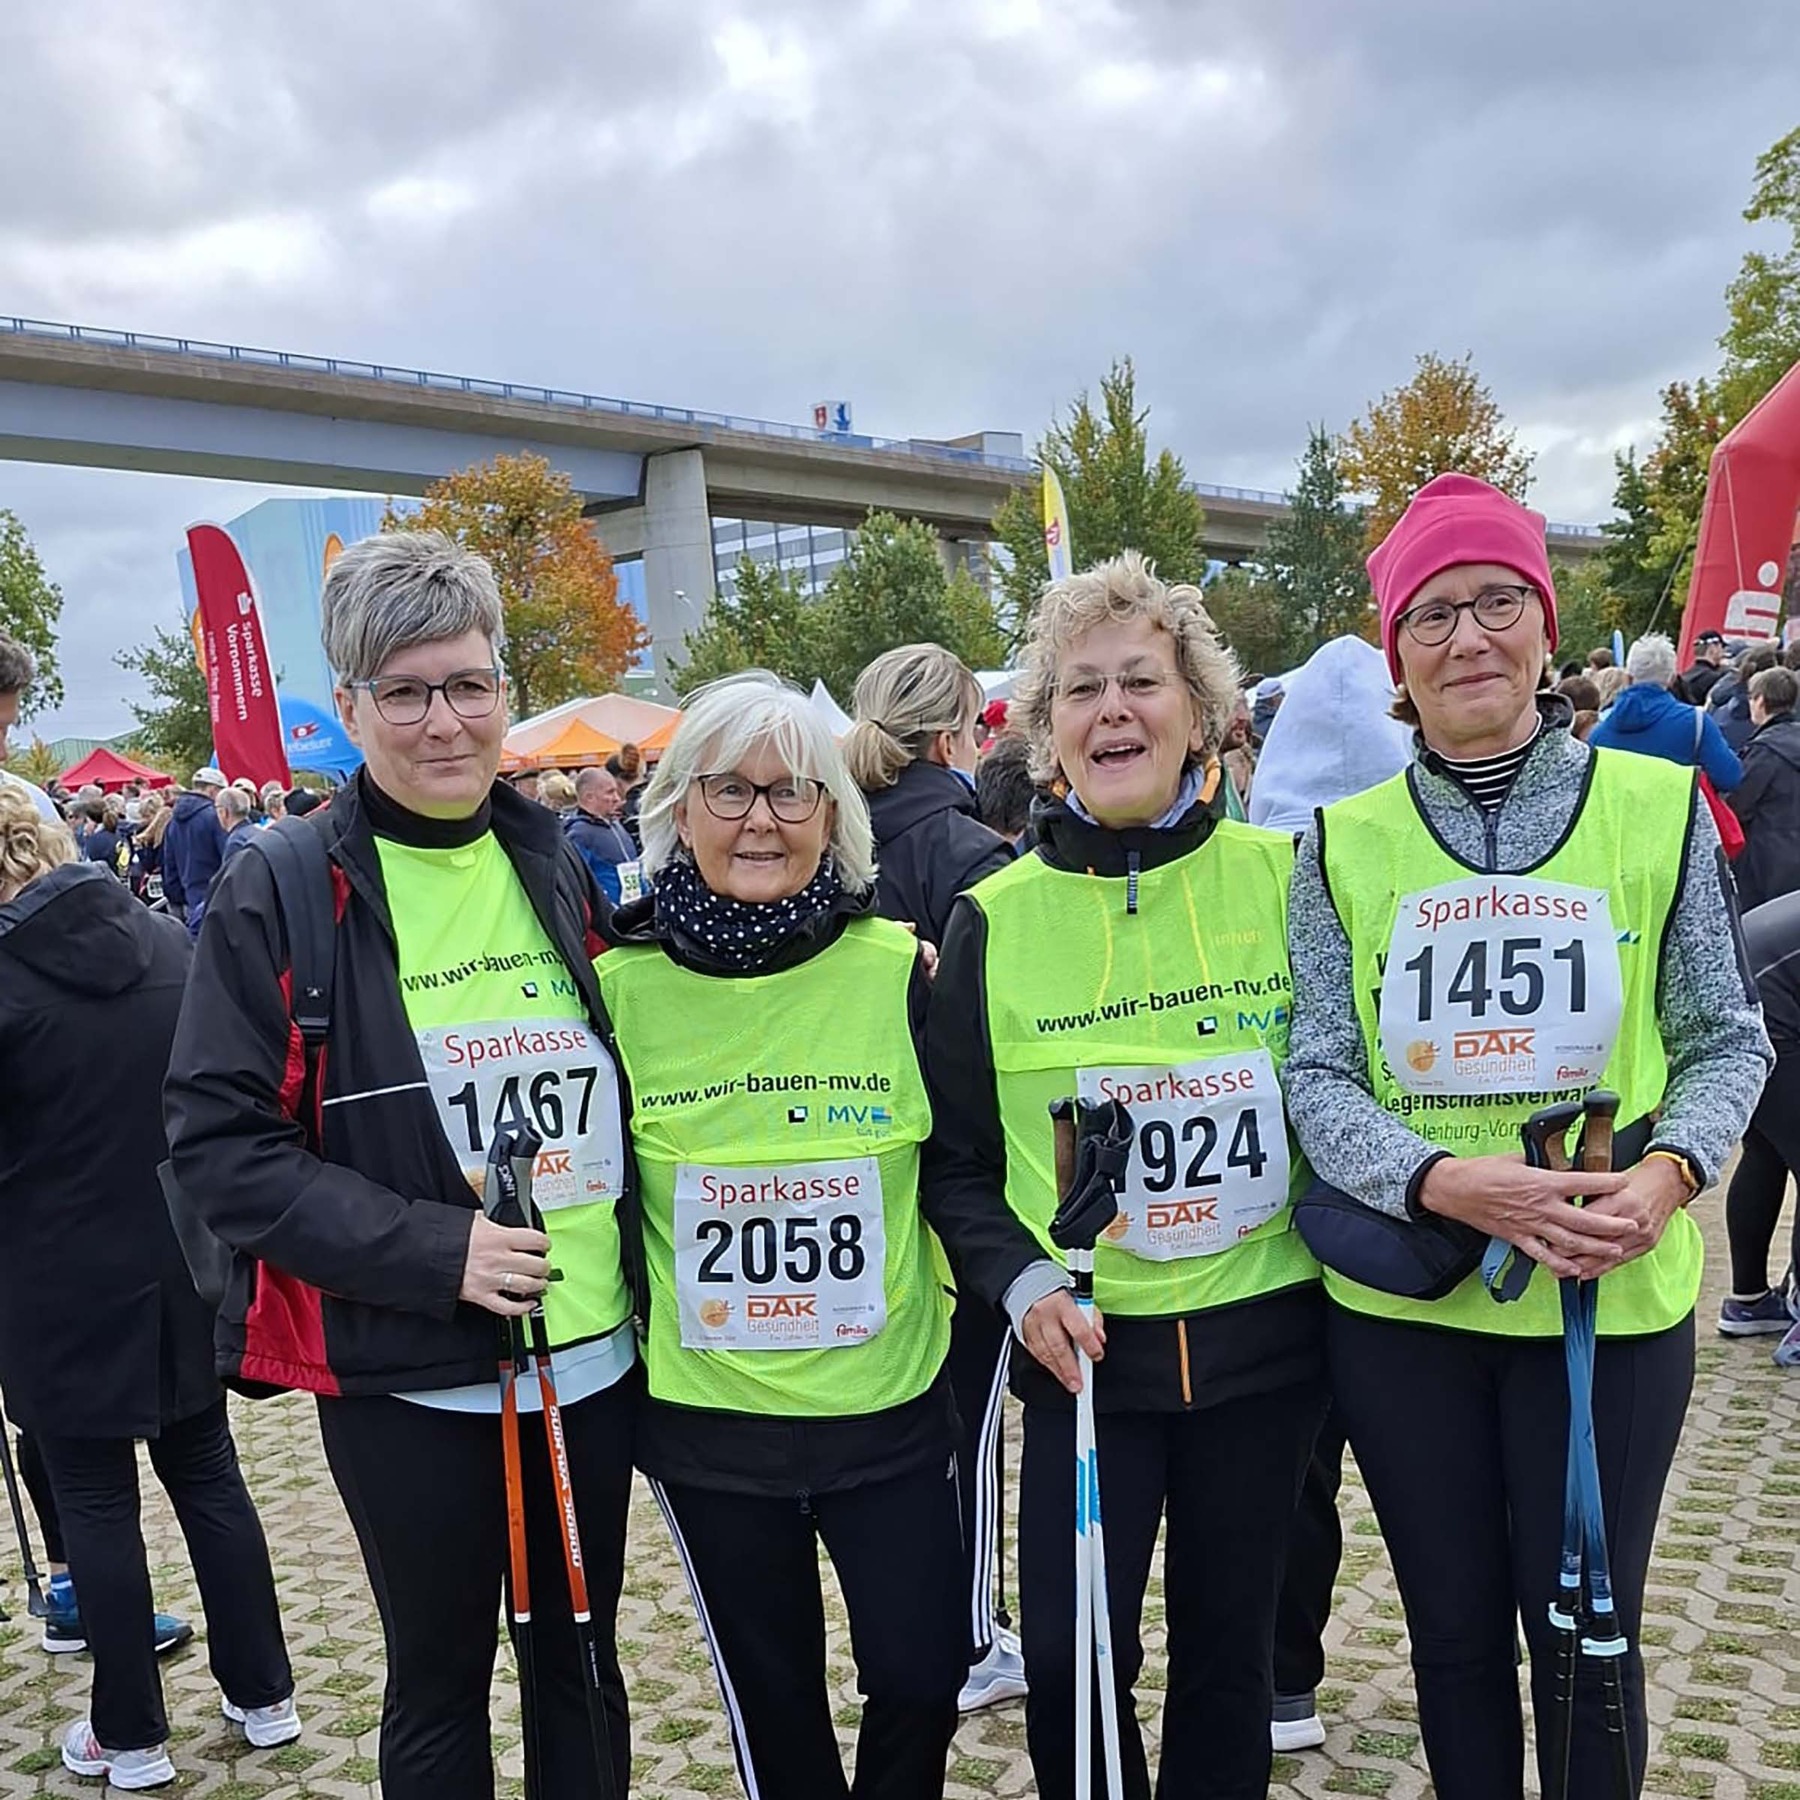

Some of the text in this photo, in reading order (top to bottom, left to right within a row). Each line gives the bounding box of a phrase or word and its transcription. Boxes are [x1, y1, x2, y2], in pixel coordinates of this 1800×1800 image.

[227, 624, 247, 721] Vorpommern
[242, 621, 262, 698] Sparkasse
[1415, 885, 1588, 931] Sparkasse
[1404, 938, 1587, 1022] 1451
[444, 1027, 588, 1068] Sparkasse
[1454, 1028, 1535, 1058] DAK
[1454, 1058, 1536, 1077] Gesundheit
[641, 1073, 891, 1108] www.wir-bauen-mv.de
[1100, 1068, 1254, 1106] Sparkasse
[448, 1067, 598, 1152] 1467
[828, 1106, 868, 1124] MV
[532, 1151, 573, 1178] AK
[701, 1174, 860, 1209] Sparkasse
[1147, 1198, 1219, 1229] DAK
[696, 1214, 866, 1285] 2058
[1146, 1223, 1221, 1246] Gesundheit
[747, 1294, 818, 1318] DAK
[748, 1318, 820, 1333] Gesundheit
